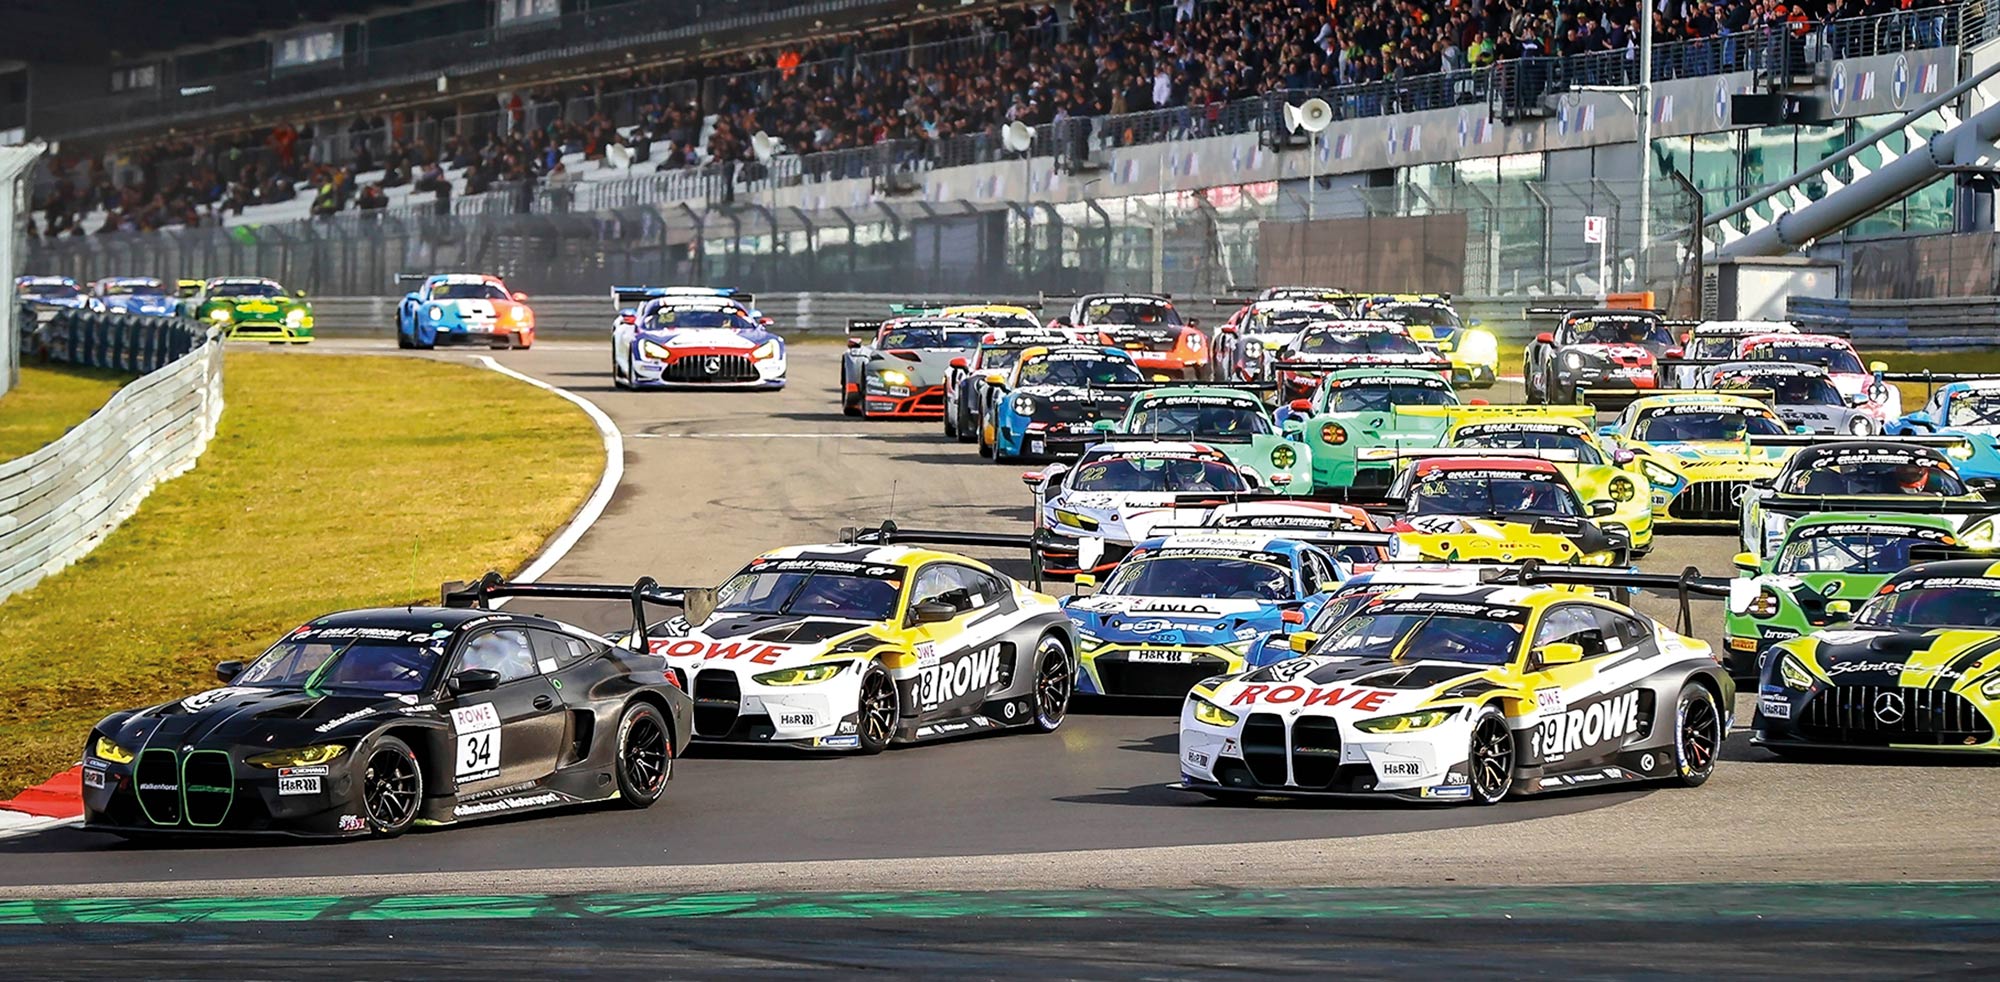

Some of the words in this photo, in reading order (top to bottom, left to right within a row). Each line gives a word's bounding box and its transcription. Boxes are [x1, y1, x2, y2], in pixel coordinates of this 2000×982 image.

[1080, 465, 1108, 482] 22
[1250, 517, 1283, 526] GRAN
[1282, 517, 1334, 528] TURISMO
[1418, 518, 1455, 533] 44
[1160, 549, 1192, 557] GRAN
[1191, 549, 1247, 558] TURISMO
[781, 560, 813, 568] GRAN
[811, 560, 866, 571] TURISMO
[1398, 602, 1430, 610] GRAN
[1428, 602, 1488, 613] TURISMO
[321, 627, 353, 636] GRAN
[352, 627, 411, 640] TURISMO
[1119, 621, 1216, 634] SCHERER
[1763, 629, 1799, 639] brose
[648, 639, 792, 665] ROWE
[916, 644, 935, 660] OWE
[938, 643, 1001, 704] ROWE
[1230, 685, 1398, 712] ROWE
[1538, 690, 1561, 707] OWE
[457, 706, 491, 726] ROWE
[781, 715, 802, 725] H&R
[1565, 689, 1640, 754] ROWE
[466, 733, 491, 768] 34
[1384, 763, 1407, 775] H&R
[140, 783, 178, 791] Walkenhorst
[280, 780, 303, 791] H&R
